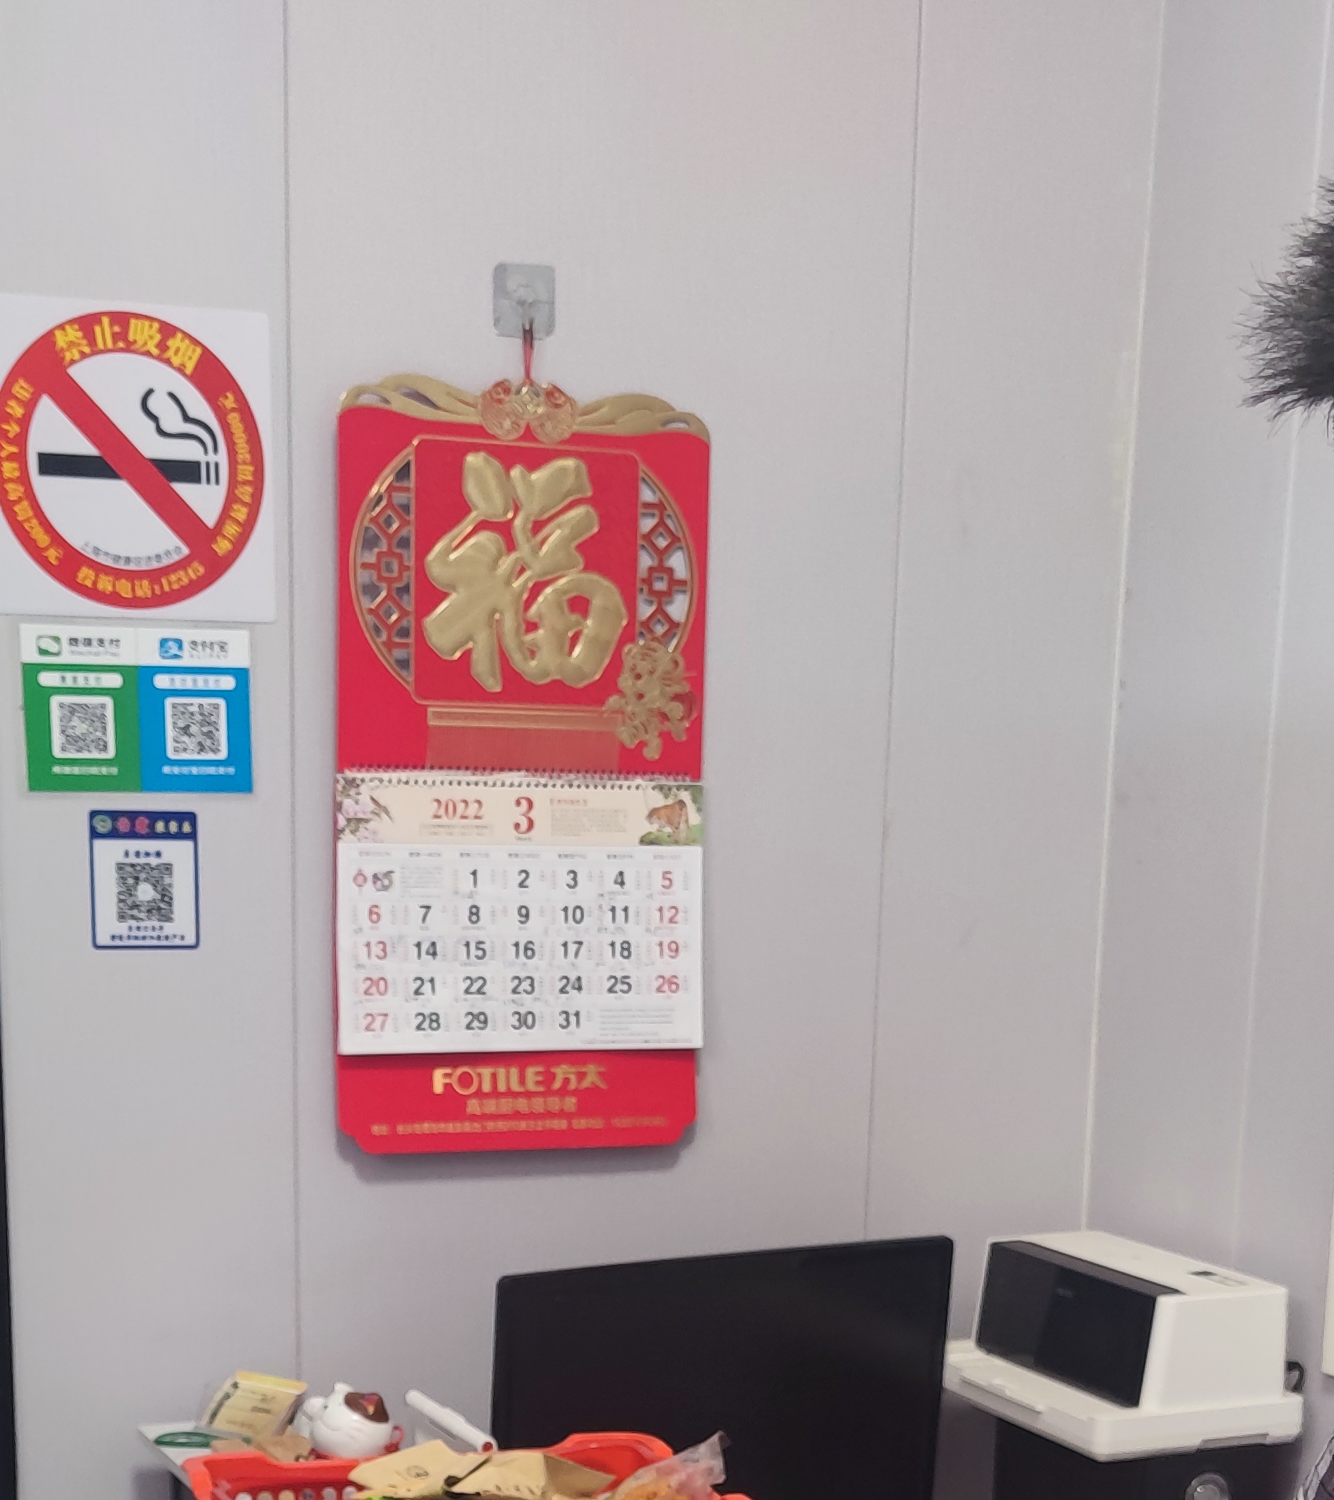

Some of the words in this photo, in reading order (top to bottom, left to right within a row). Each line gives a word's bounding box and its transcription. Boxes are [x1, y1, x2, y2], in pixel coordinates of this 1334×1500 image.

[52, 315, 204, 376] 禁止吸烟
[423, 452, 629, 693] 福
[430, 798, 485, 821] 2022
[513, 796, 536, 836] 3
[469, 868, 478, 889] 1
[518, 869, 530, 889] 2
[566, 869, 578, 890] 3
[613, 870, 626, 889] 4
[662, 870, 673, 890] 5
[368, 904, 381, 924] 6
[419, 904, 433, 924] 7
[467, 904, 481, 925] 8
[517, 904, 530, 925] 9
[562, 904, 585, 925] 10
[609, 905, 630, 924] 11
[658, 905, 679, 925] 12
[365, 940, 388, 960] 13
[414, 940, 438, 961] 14
[464, 940, 487, 961] 15
[513, 940, 536, 960] 16
[562, 940, 584, 960] 17
[609, 939, 632, 960] 18
[658, 940, 680, 959] 19
[363, 976, 388, 996] 20
[413, 976, 436, 997] 21
[463, 975, 487, 996] 22
[511, 975, 536, 996] 23
[558, 975, 583, 995] 24
[606, 974, 633, 995] 25
[655, 974, 680, 994] 26
[364, 1012, 388, 1032] 27
[414, 1011, 441, 1032] 28
[465, 1011, 489, 1031] 29
[511, 1010, 537, 1031] 30
[558, 1010, 581, 1030] 31
[431, 1066, 545, 1096] FOTILE
[549, 1064, 608, 1091] 方太
